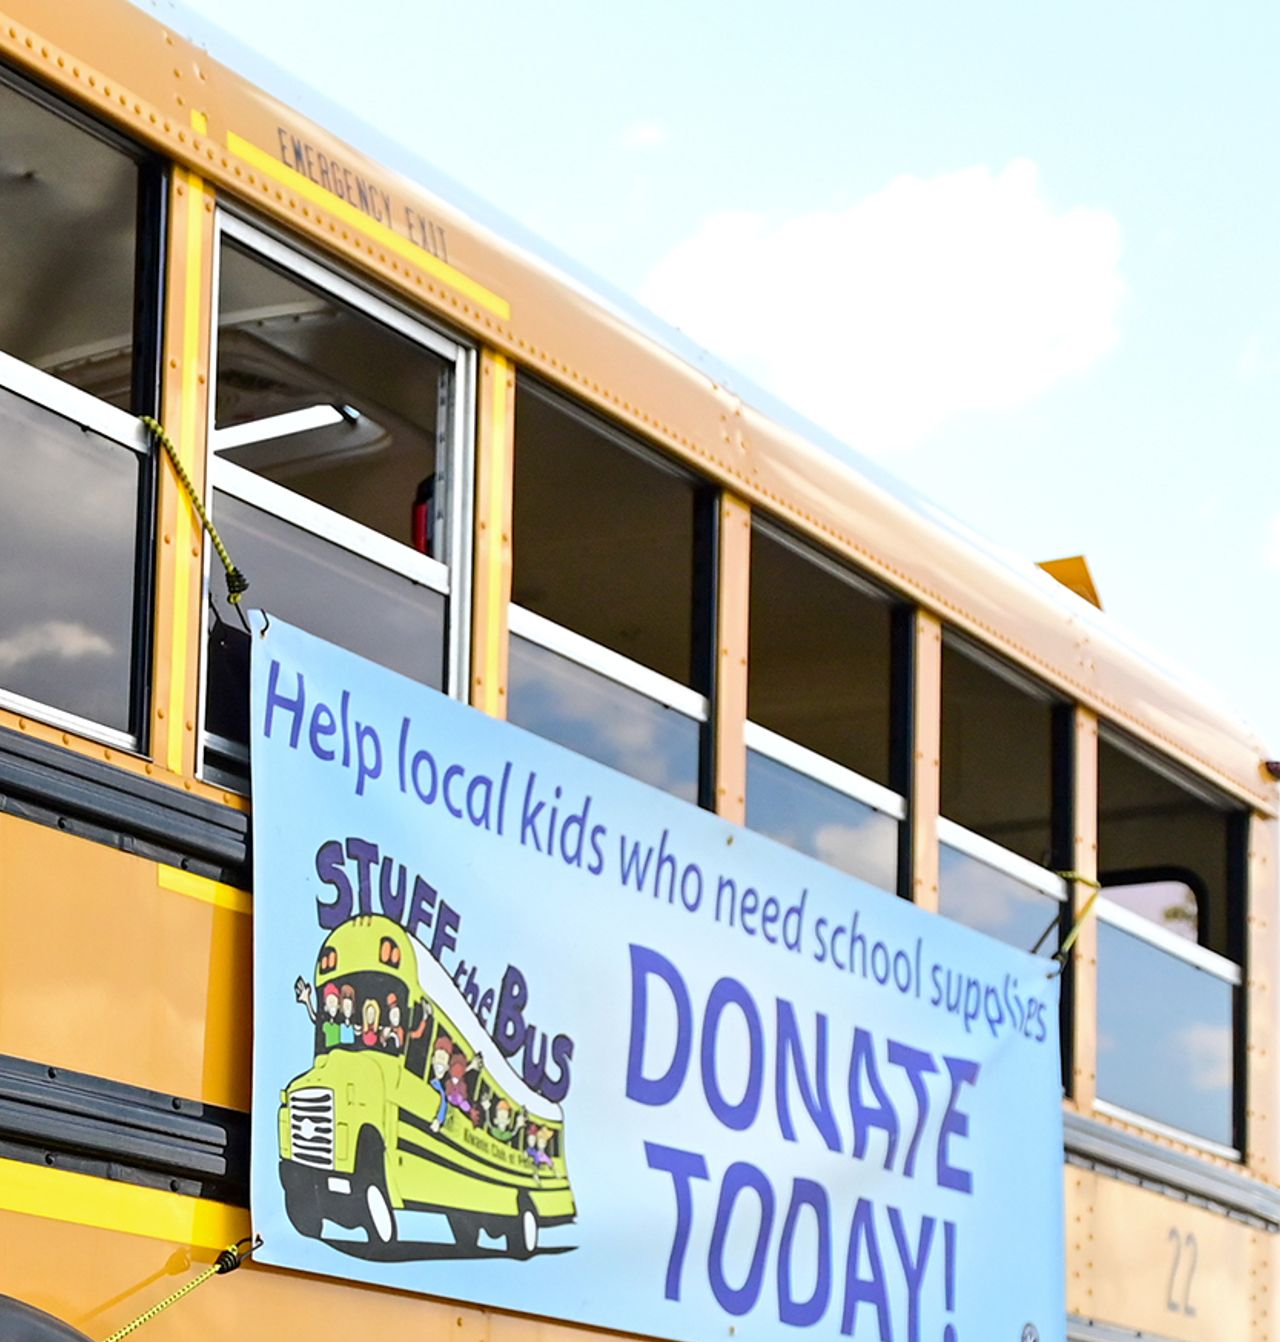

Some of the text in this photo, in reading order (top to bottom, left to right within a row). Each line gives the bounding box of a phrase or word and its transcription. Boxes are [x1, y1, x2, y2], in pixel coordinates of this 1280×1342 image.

[277, 127, 450, 264] EMERGENCY EXIT
[263, 659, 1047, 1044] Help local kids who need school supplies
[314, 837, 461, 962] STUFF
[453, 959, 495, 1027] the
[626, 943, 982, 1196] DONATE
[1165, 1226, 1199, 1318] 22
